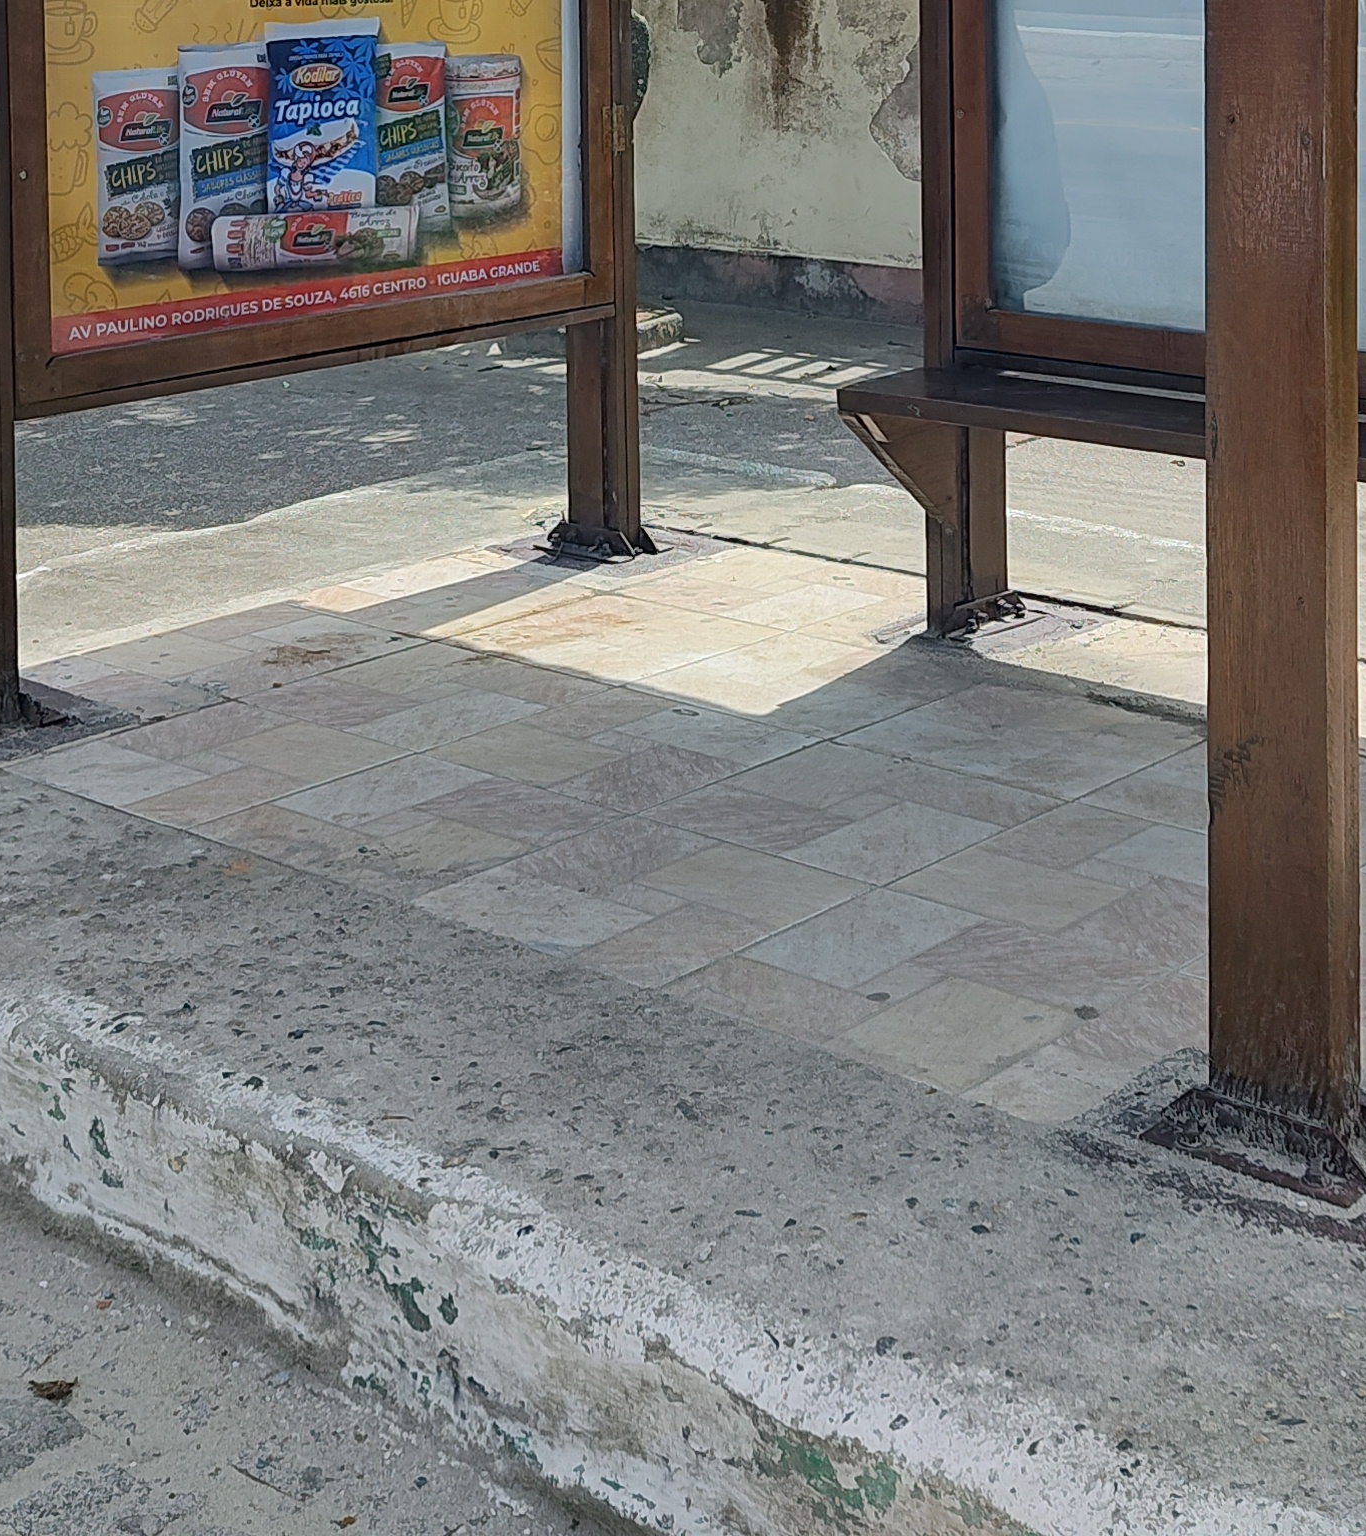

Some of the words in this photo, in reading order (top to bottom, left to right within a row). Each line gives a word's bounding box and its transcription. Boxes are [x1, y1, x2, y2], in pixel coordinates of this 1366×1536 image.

[285, 0, 292, 7] a
[294, 65, 339, 85] Kodilar
[274, 94, 360, 125] Tapioca
[380, 121, 417, 148] CHIPS
[196, 144, 244, 176] CHIPS
[111, 160, 157, 190] CHIPS
[454, 172, 486, 188] Arroz
[69, 324, 93, 341] AV
[96, 314, 168, 337] PAULINO
[172, 300, 259, 326] RODRIGUES
[262, 298, 283, 312] DE
[285, 290, 337, 308] SOUZA,
[339, 283, 370, 300] 4616
[372, 276, 427, 296] CENTRO
[437, 269, 488, 286] IGUABA
[490, 260, 540, 279] GRANDE
